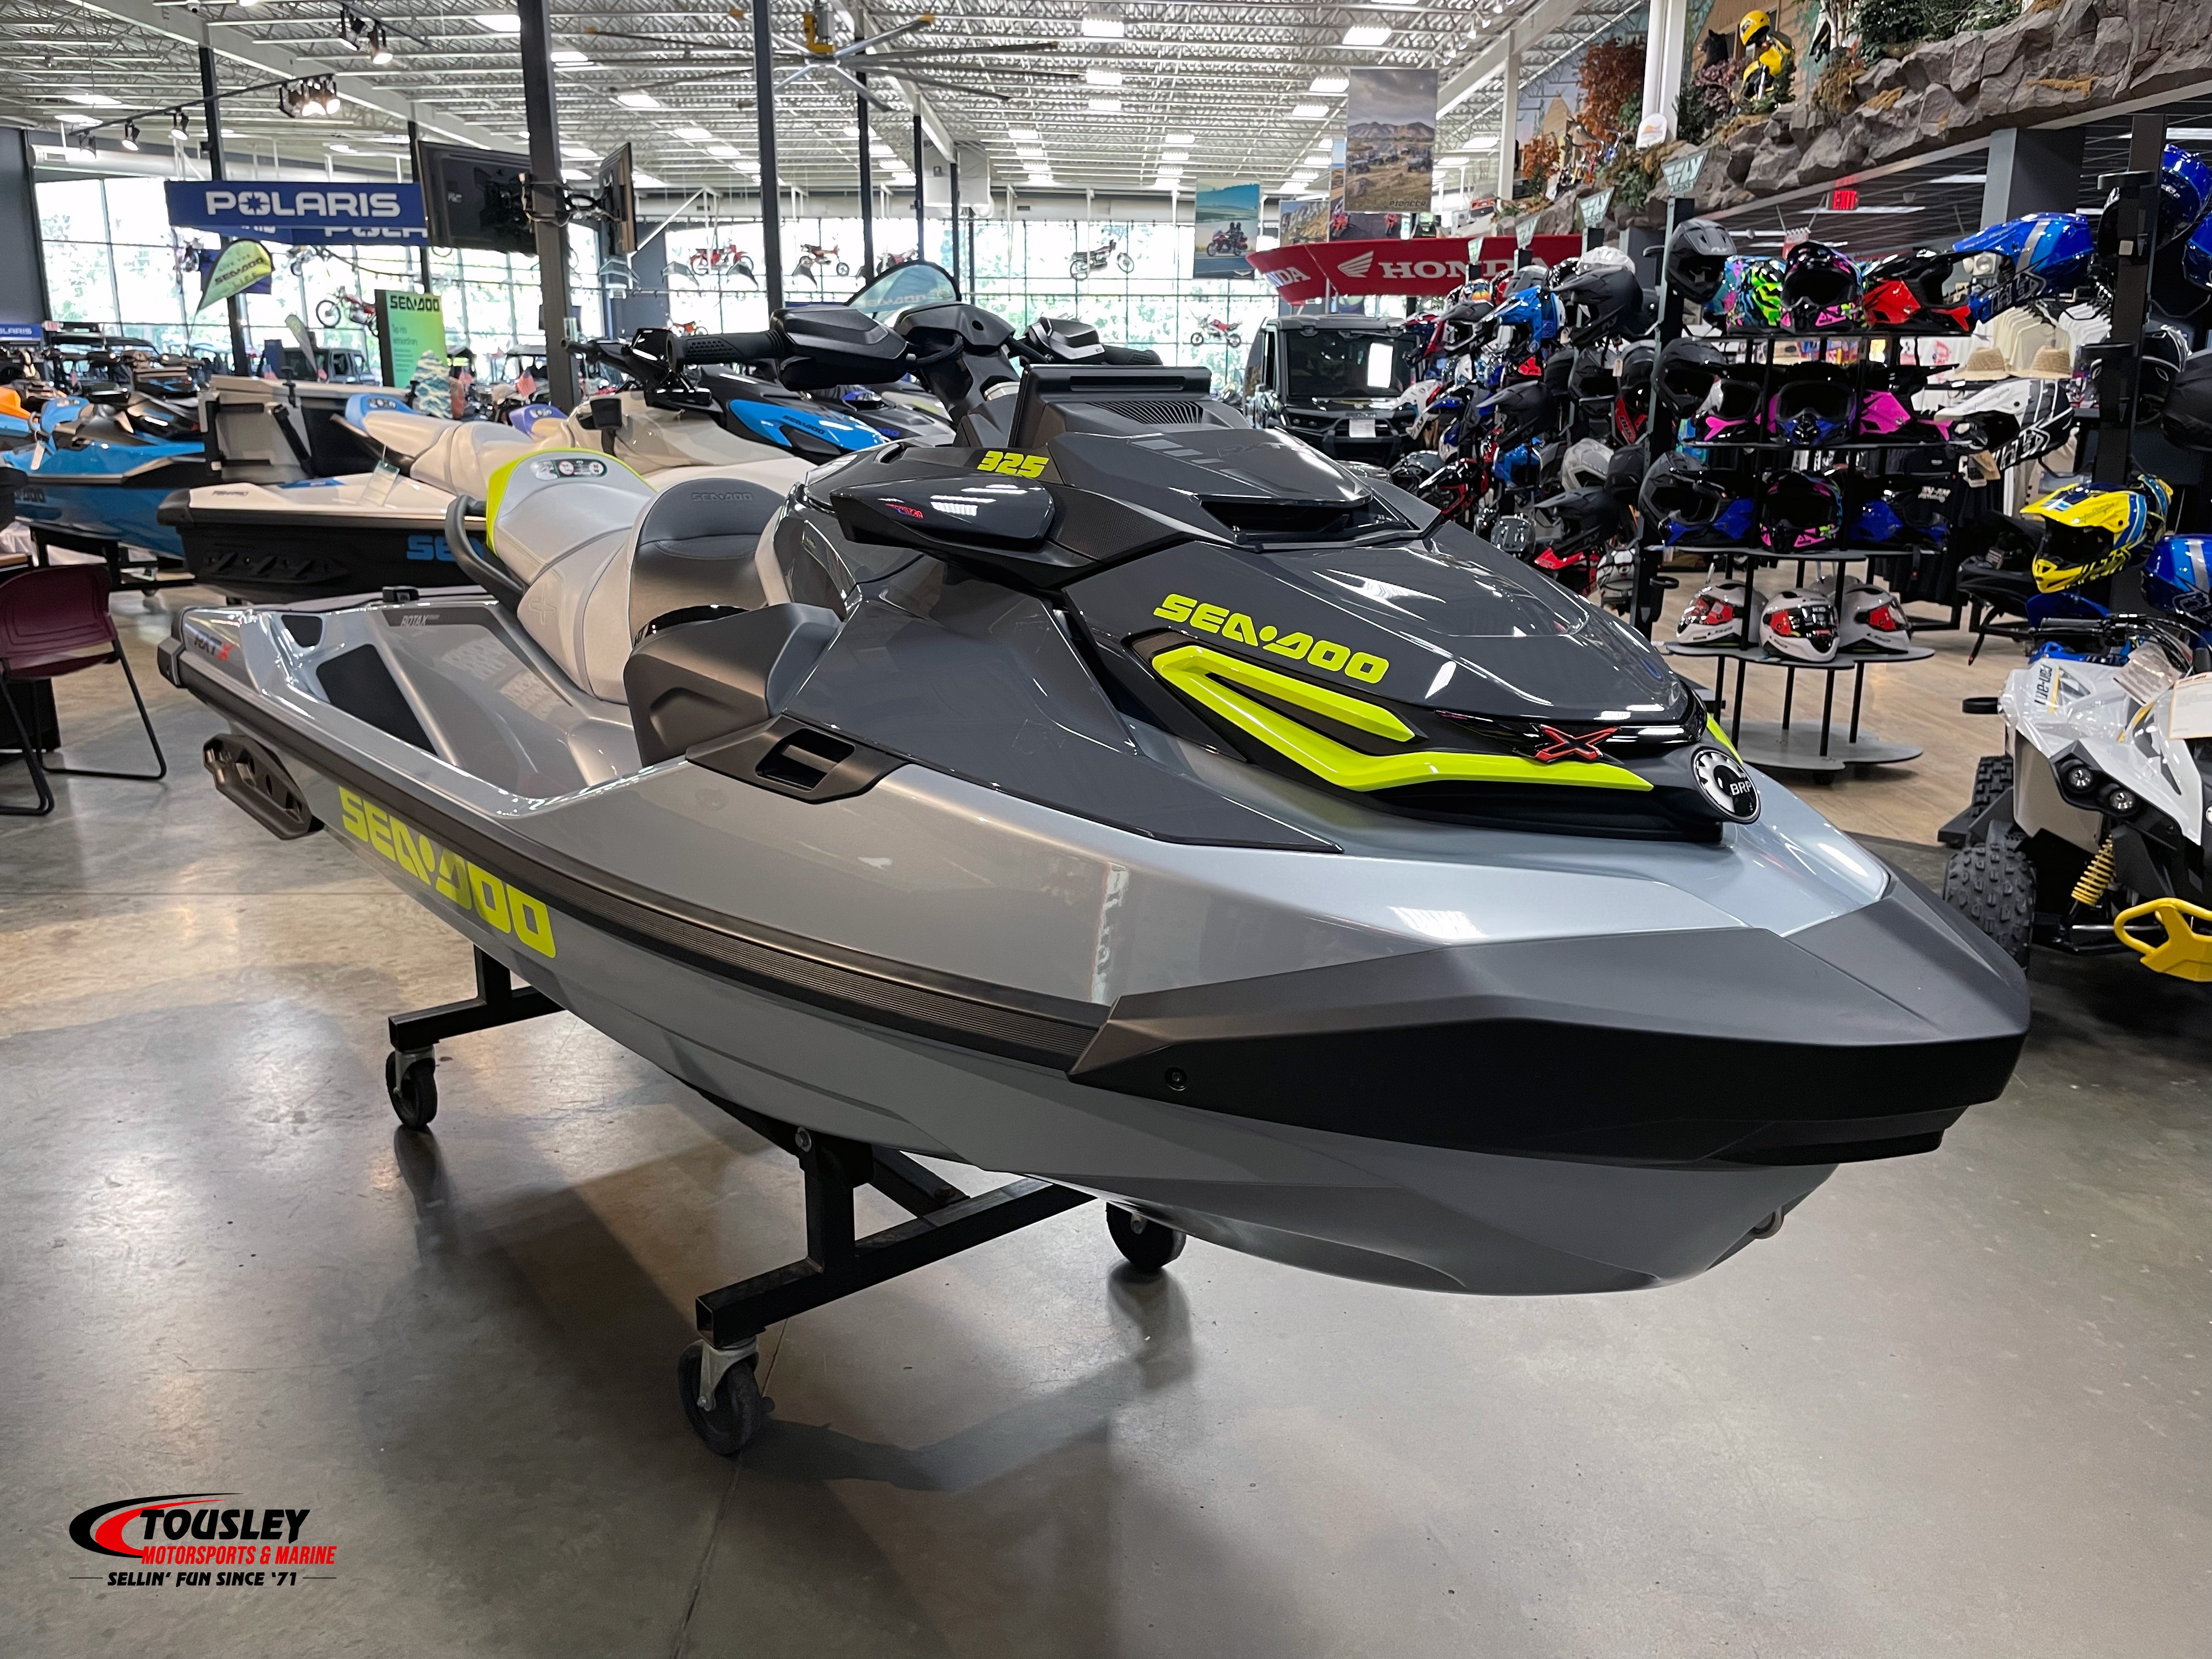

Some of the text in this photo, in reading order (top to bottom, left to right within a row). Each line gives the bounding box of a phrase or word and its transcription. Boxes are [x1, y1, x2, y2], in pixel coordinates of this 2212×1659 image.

[206, 191, 401, 217] POLARIS
[1833, 190, 1858, 210] EXIT
[977, 450, 1049, 478] 325
[400, 615, 428, 627] ROTAX
[1730, 781, 1752, 795] BRP
